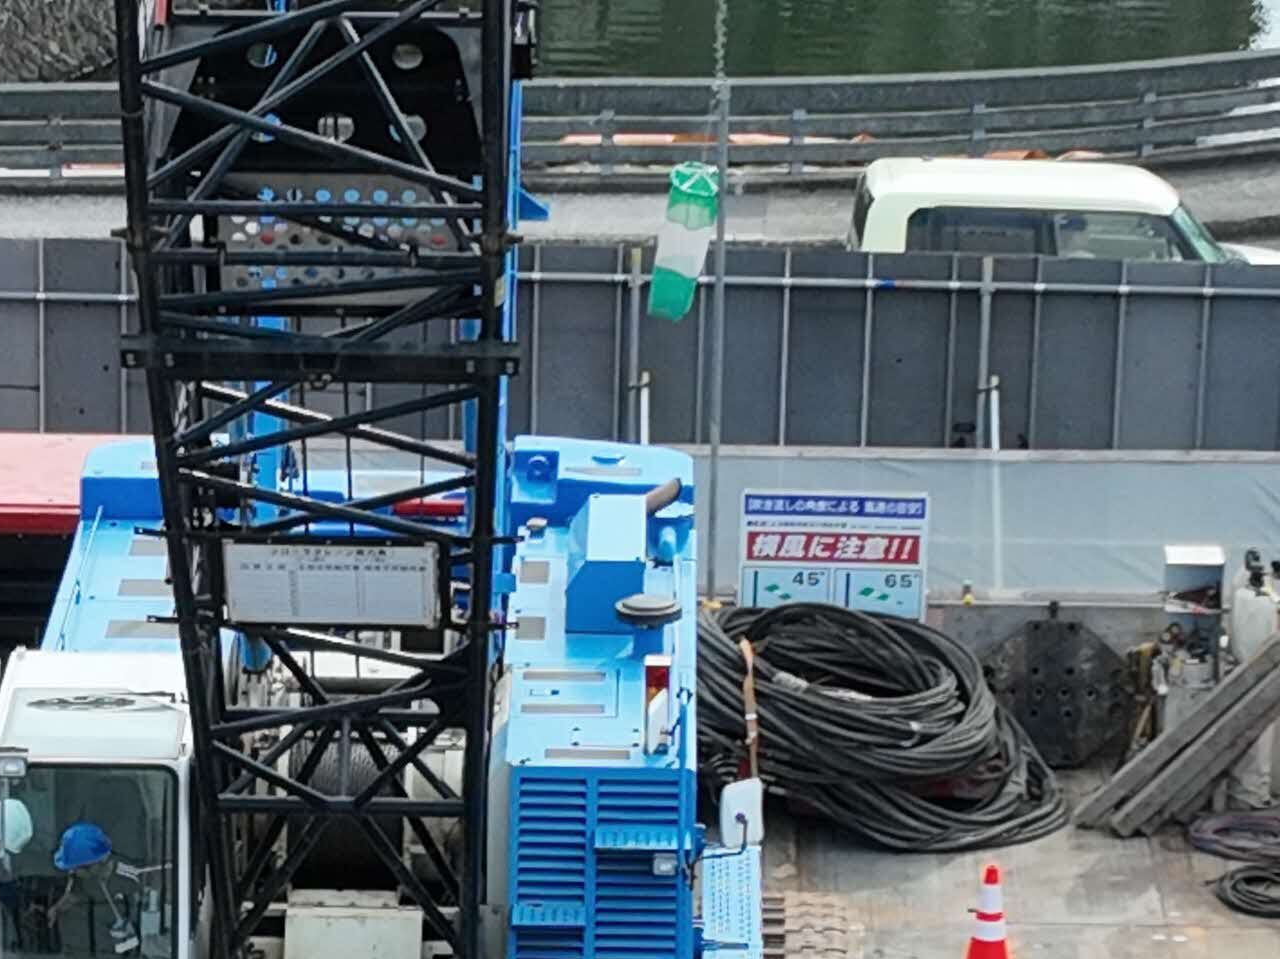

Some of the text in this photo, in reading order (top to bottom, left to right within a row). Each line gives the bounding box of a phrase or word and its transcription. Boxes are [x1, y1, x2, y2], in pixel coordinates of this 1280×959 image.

[752, 533, 914, 560] 横風に注意!!
